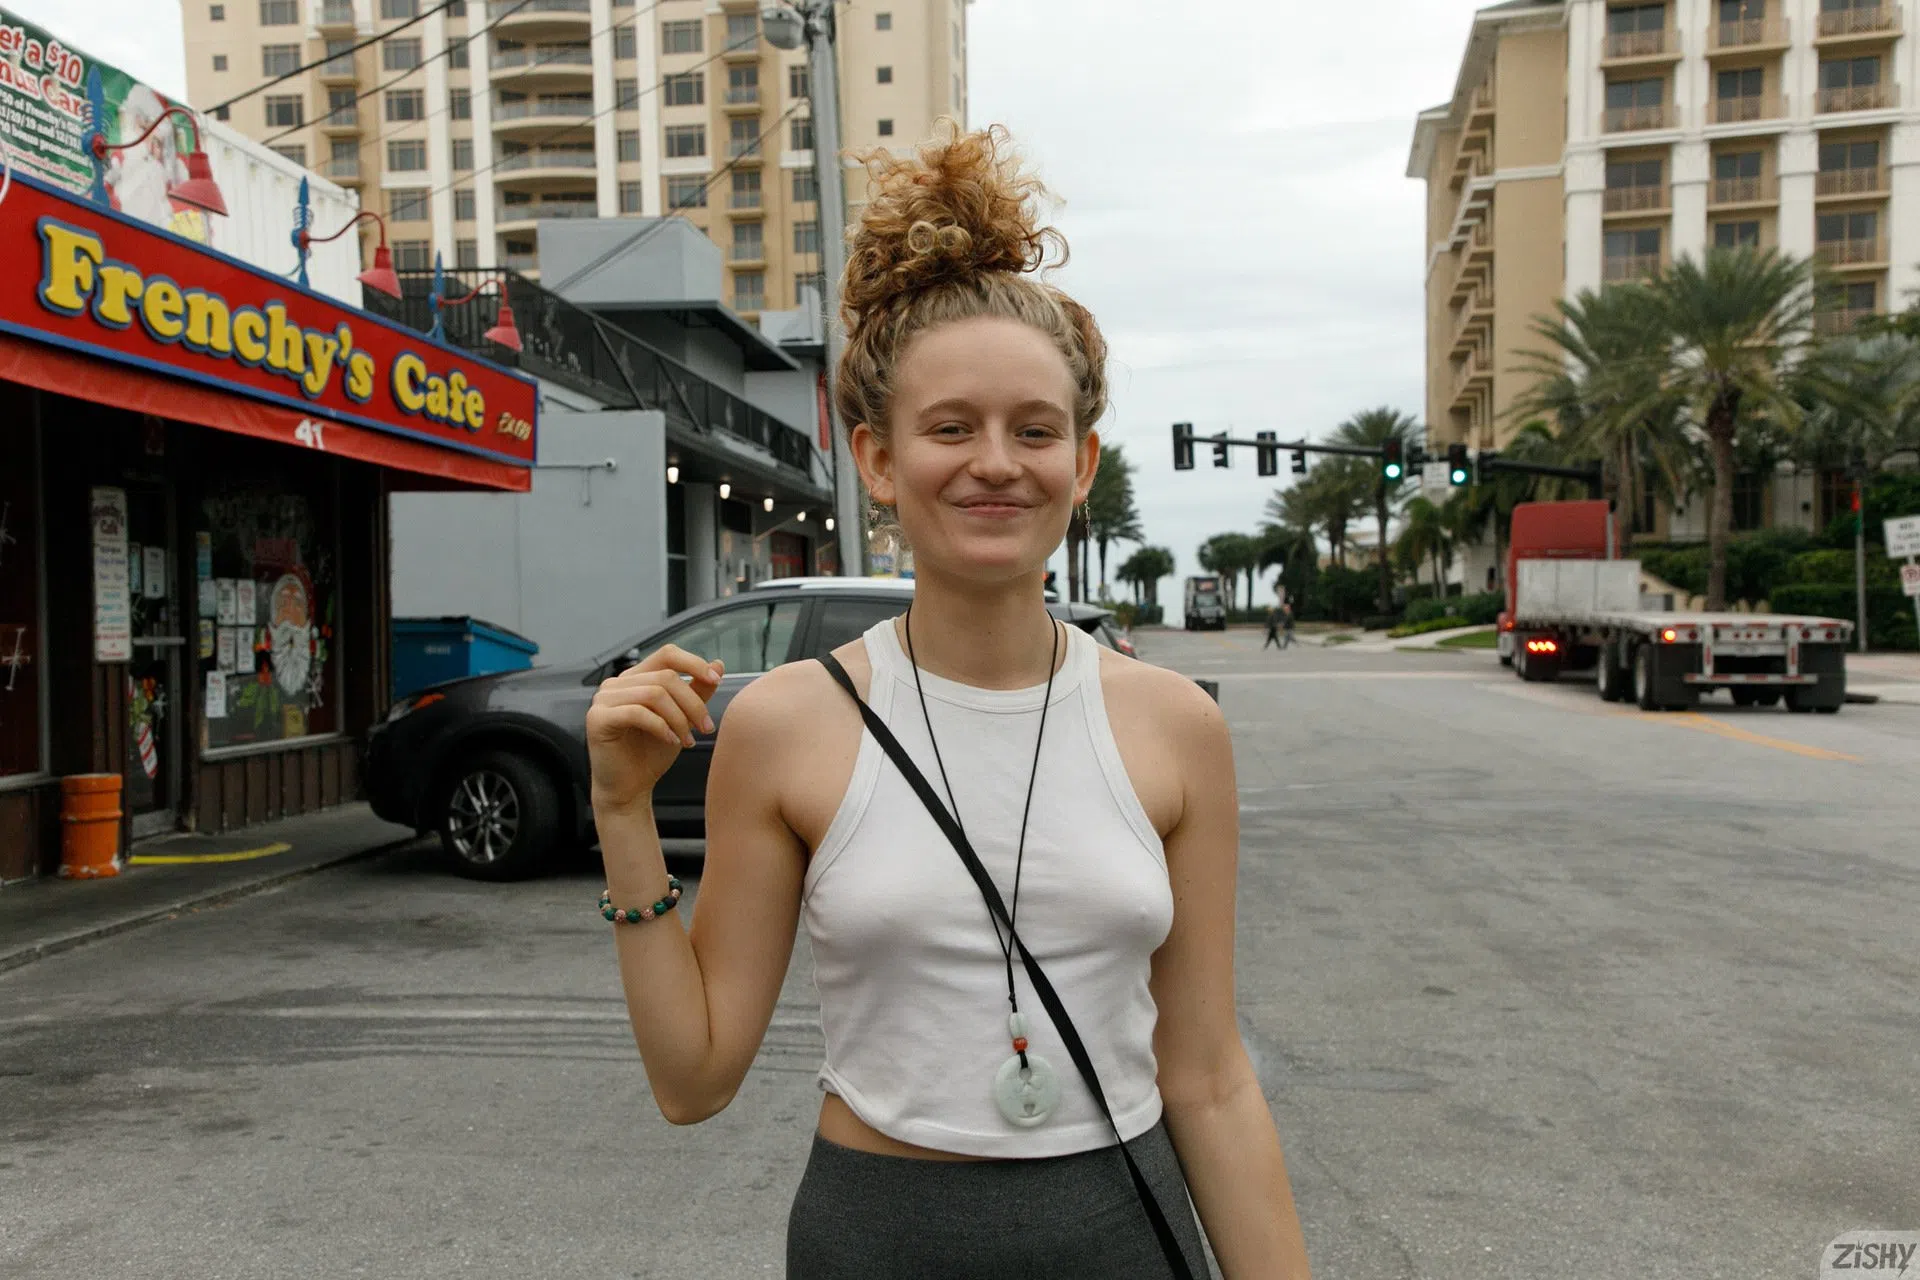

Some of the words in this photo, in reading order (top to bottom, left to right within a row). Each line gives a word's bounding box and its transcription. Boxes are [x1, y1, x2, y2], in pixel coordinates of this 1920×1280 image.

[0, 27, 24, 52] et
[26, 41, 42, 67] a
[47, 42, 82, 86] $10
[0, 60, 40, 98] nus
[41, 76, 86, 120] Car
[43, 222, 375, 399] Frenchy's
[394, 353, 485, 429] Cafe
[294, 418, 325, 450] 41
